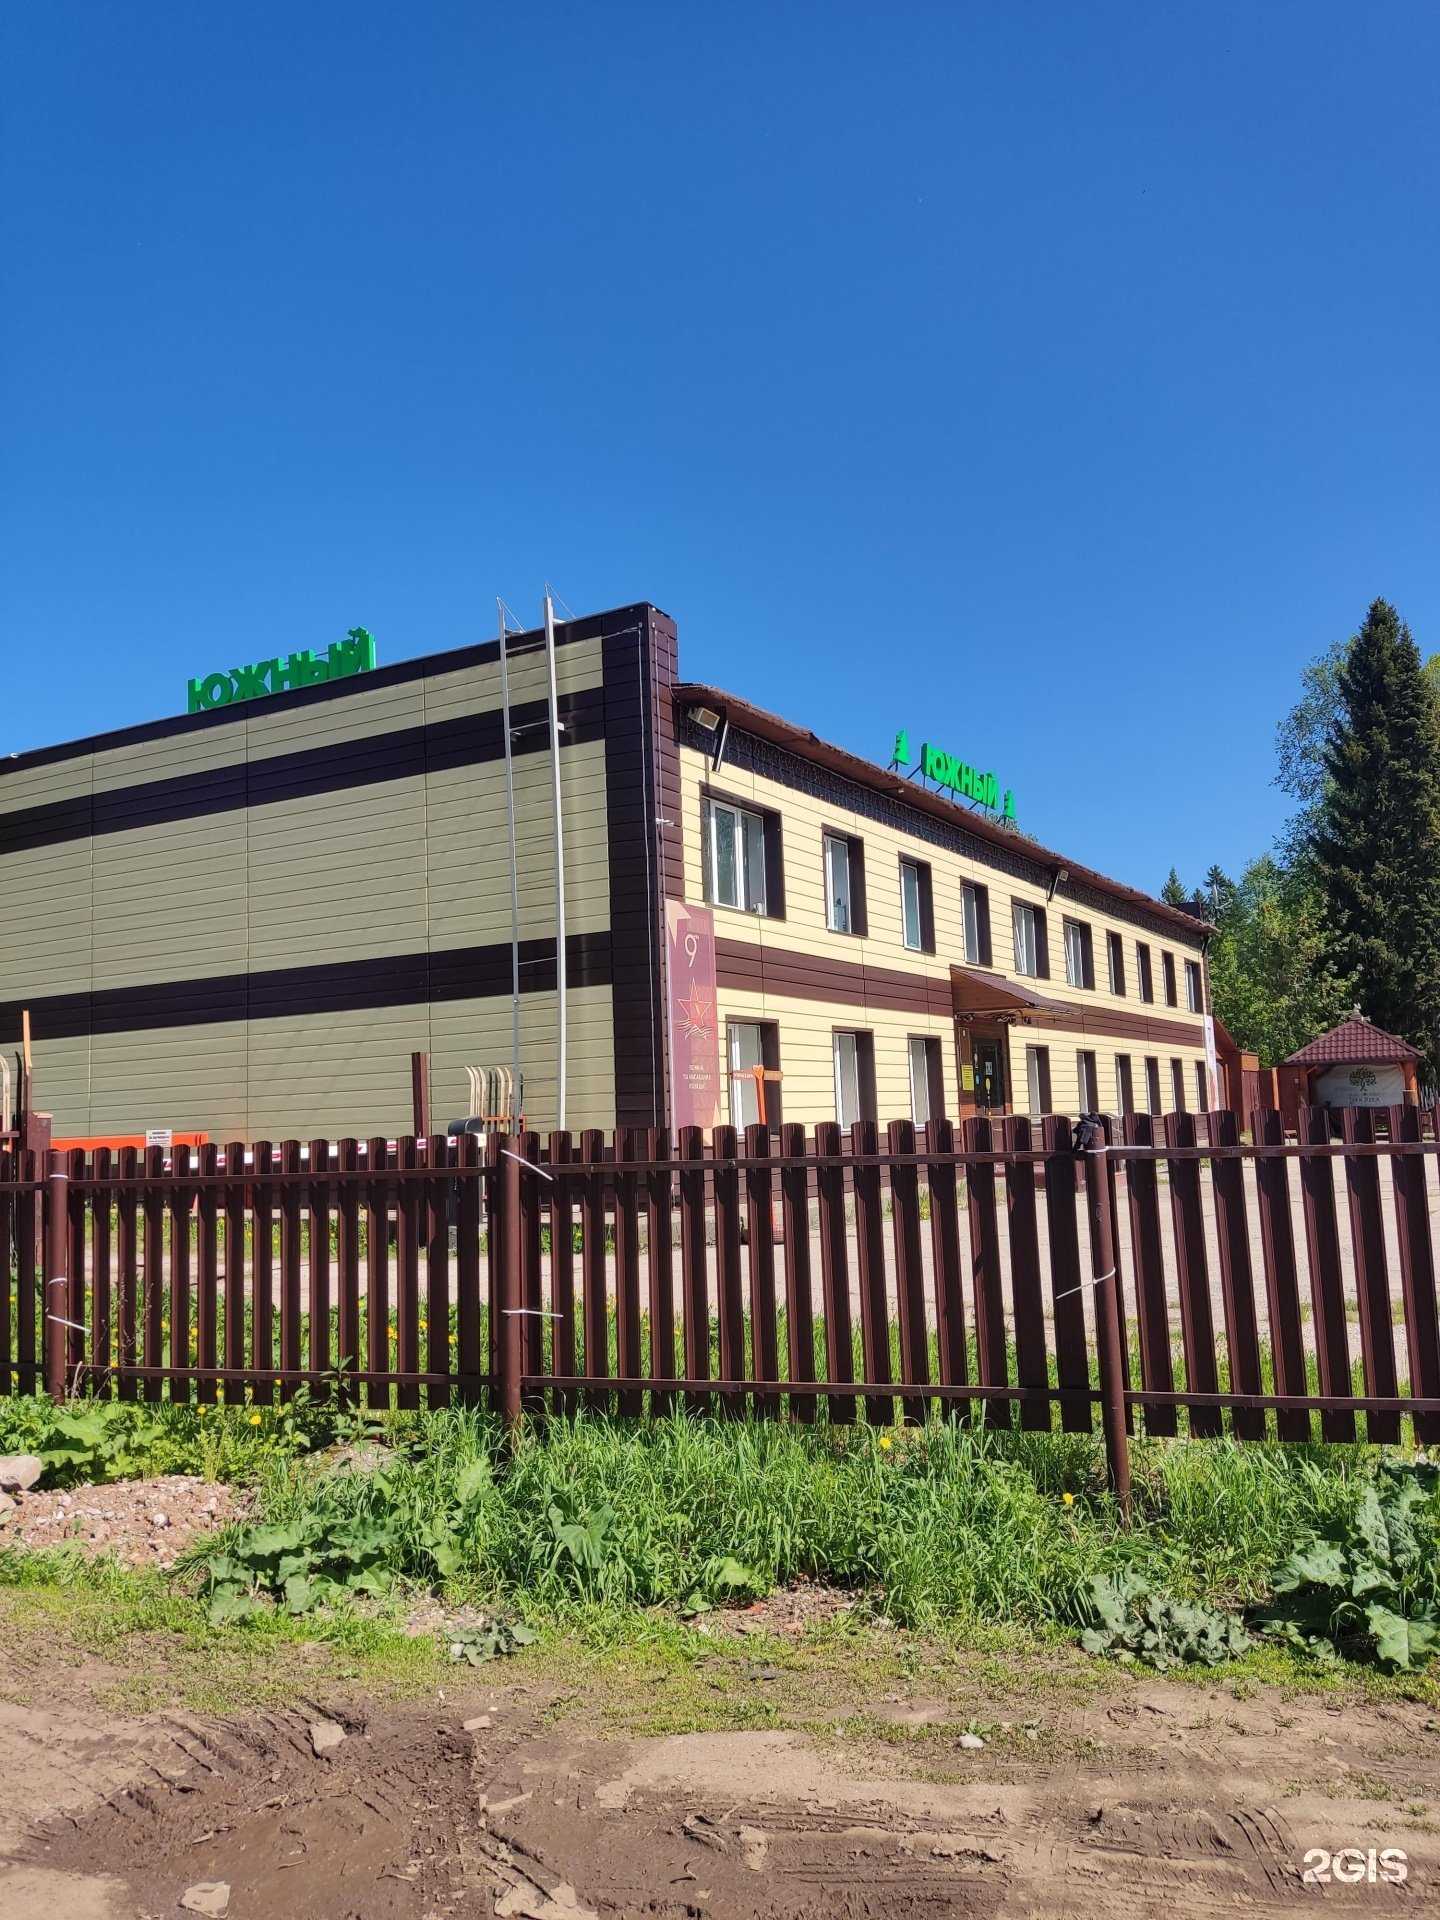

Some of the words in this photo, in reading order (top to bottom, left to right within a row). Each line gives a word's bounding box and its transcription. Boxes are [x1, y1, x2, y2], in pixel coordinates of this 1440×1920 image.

[188, 627, 376, 713] ЮЖНЫЙ
[921, 743, 998, 810] ЮЖНЫЙ
[685, 934, 697, 968] 9
